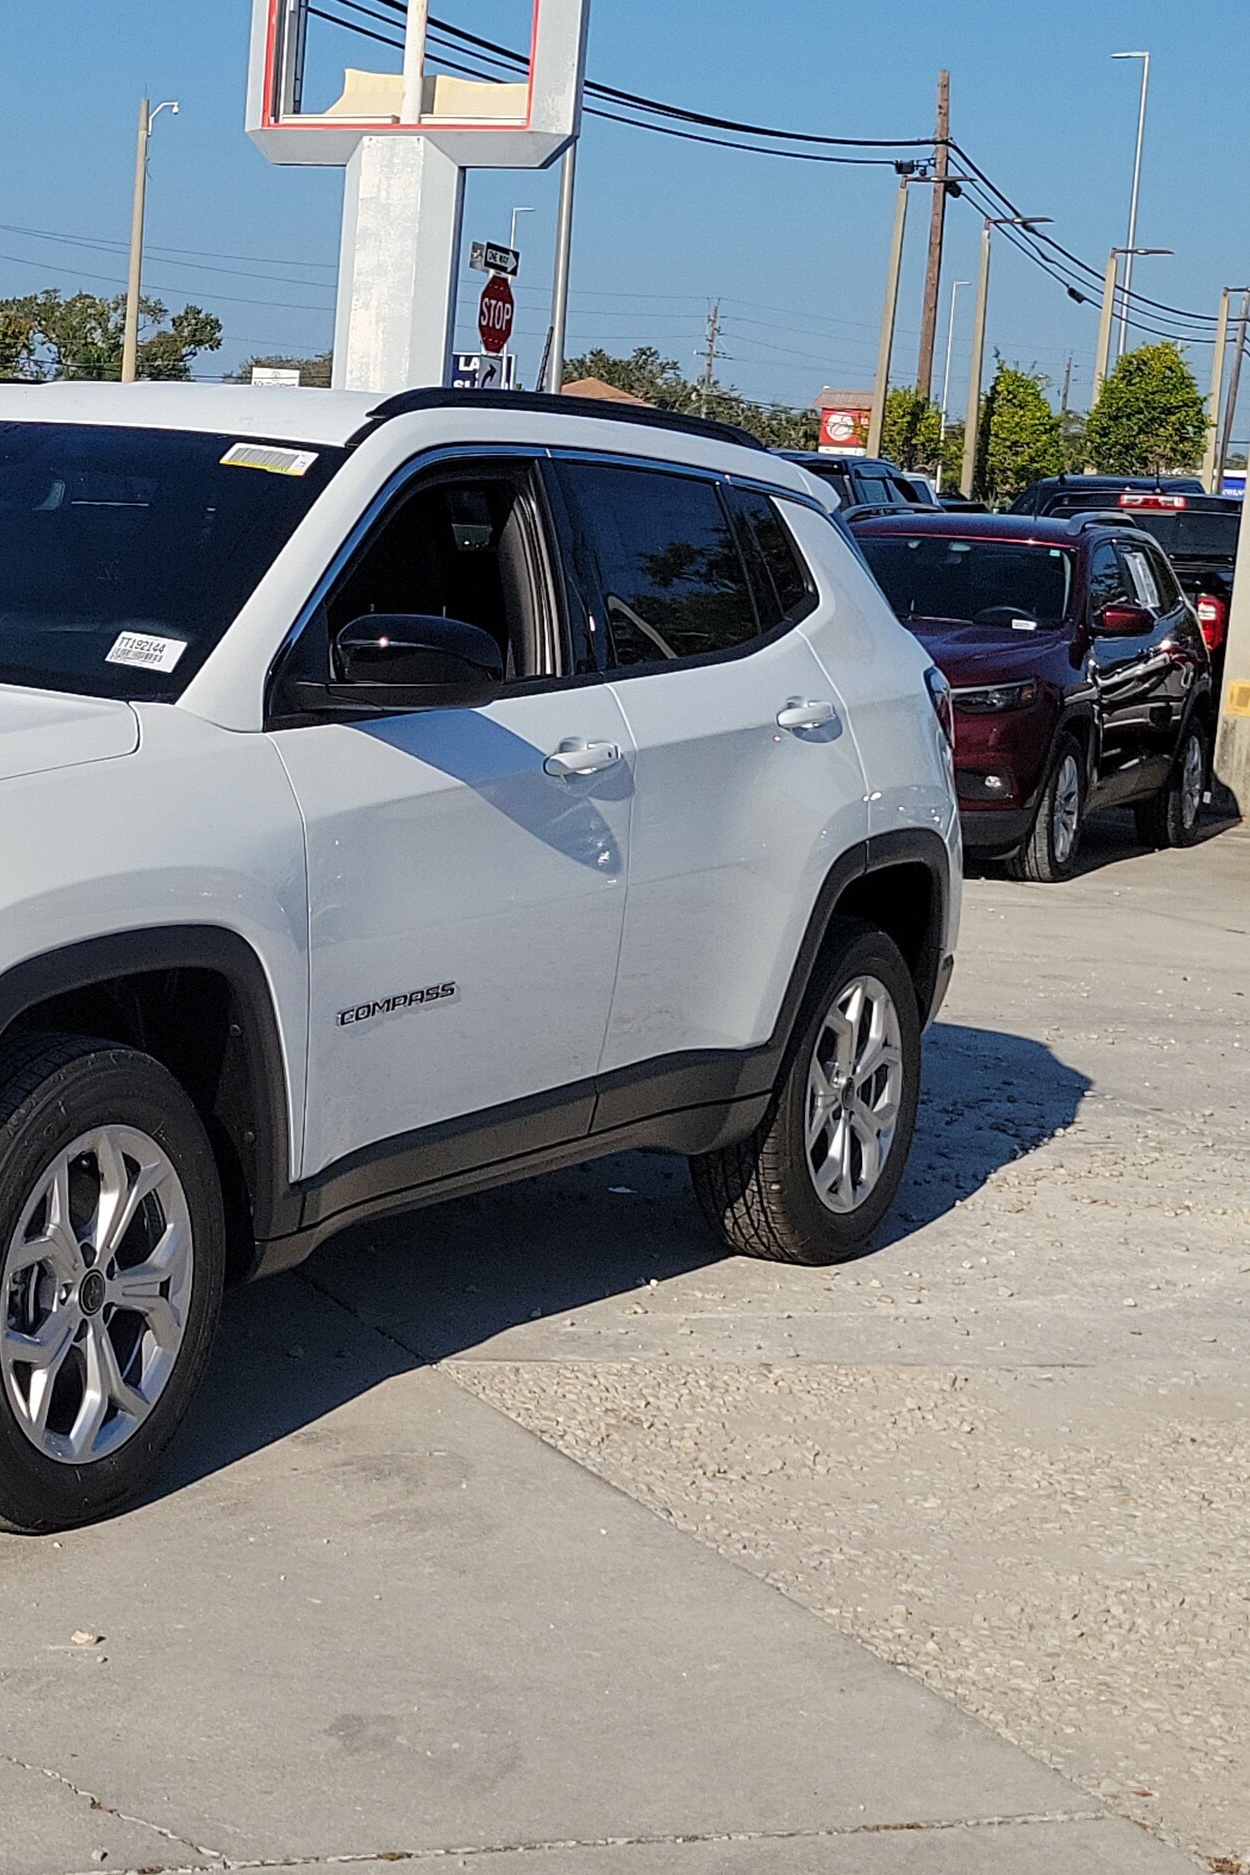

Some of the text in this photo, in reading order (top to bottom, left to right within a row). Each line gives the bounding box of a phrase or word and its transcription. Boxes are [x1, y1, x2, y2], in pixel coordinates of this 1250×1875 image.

[480, 297, 512, 331] STOP
[118, 636, 167, 654] TT192144
[337, 981, 456, 1026] COMPASS
